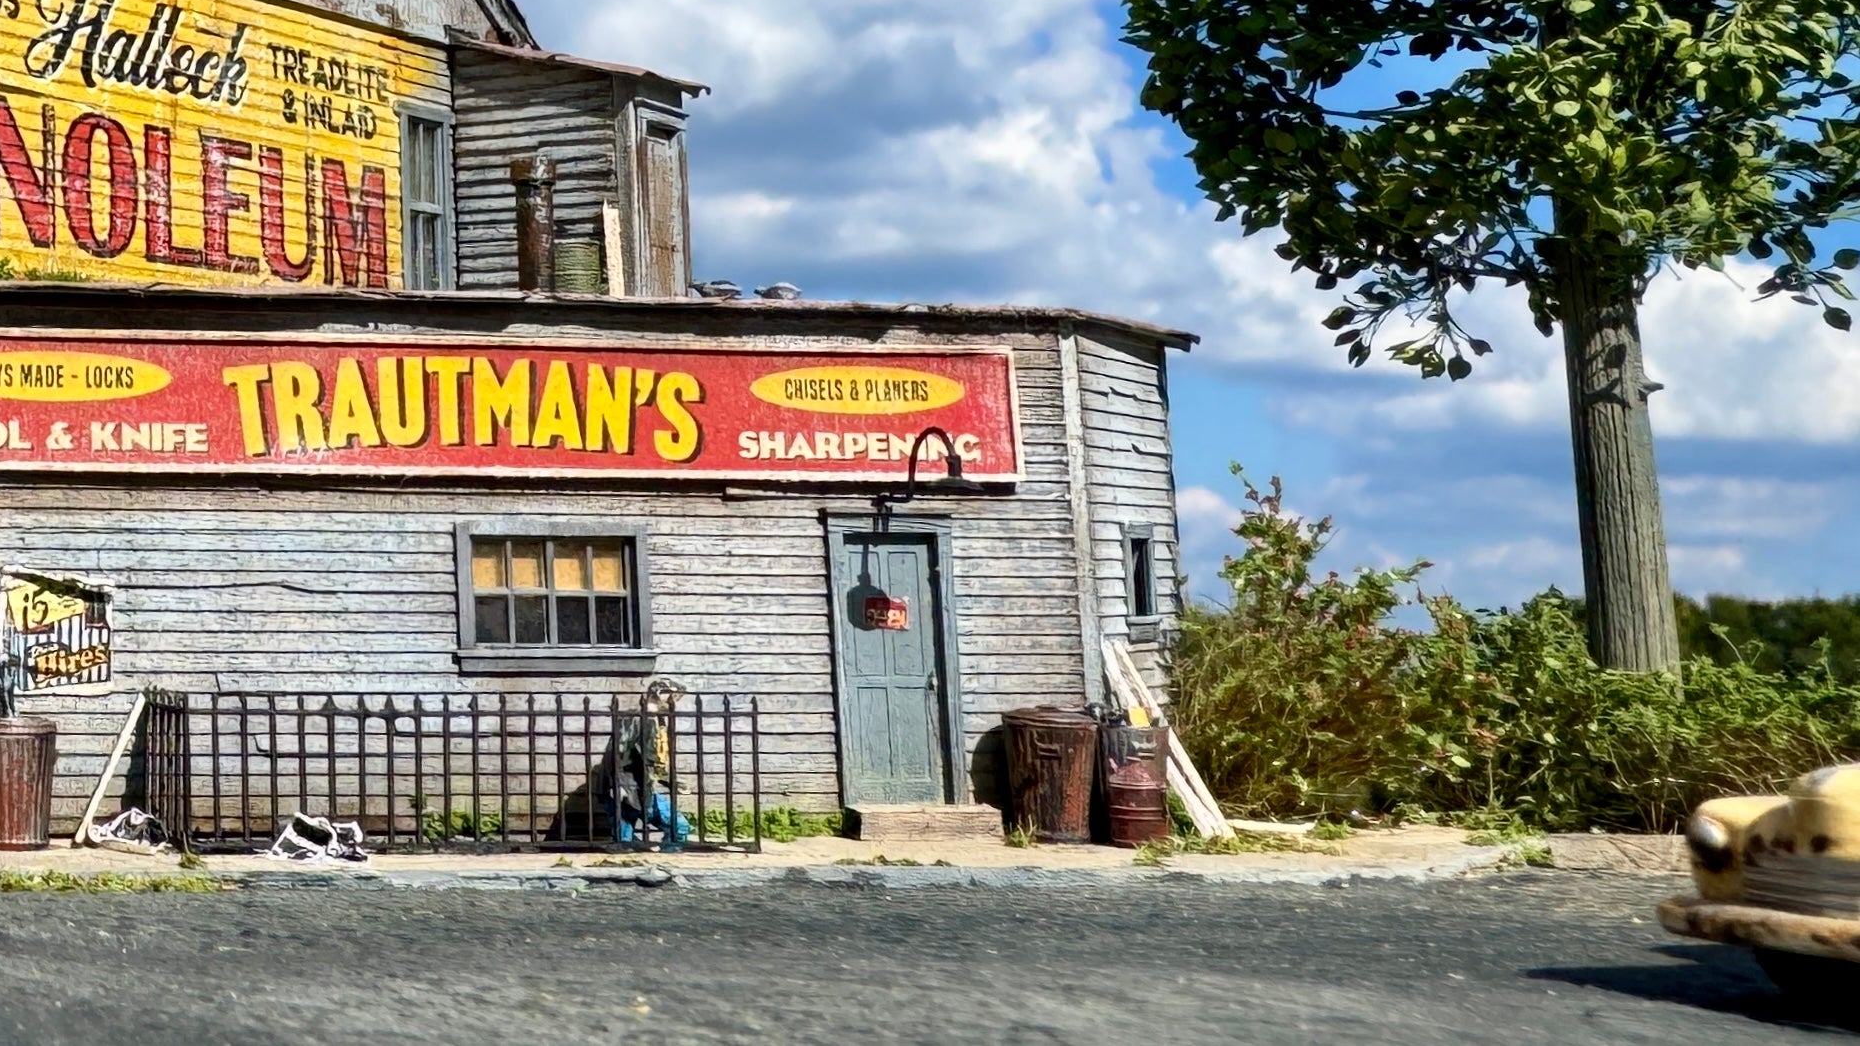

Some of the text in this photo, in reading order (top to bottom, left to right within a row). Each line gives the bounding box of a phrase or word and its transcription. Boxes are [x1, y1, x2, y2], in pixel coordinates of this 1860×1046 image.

[266, 41, 391, 105] TREADLITE
[303, 101, 378, 141] INLAID
[20, 364, 66, 390] MADE
[85, 365, 135, 390] LOCKS
[785, 378, 844, 402] CHISELS
[849, 379, 860, 401] &
[222, 354, 706, 464] TRAUTMAN'S
[45, 421, 77, 452] &
[90, 421, 210, 455] KNIFE
[36, 646, 109, 675] Hires
